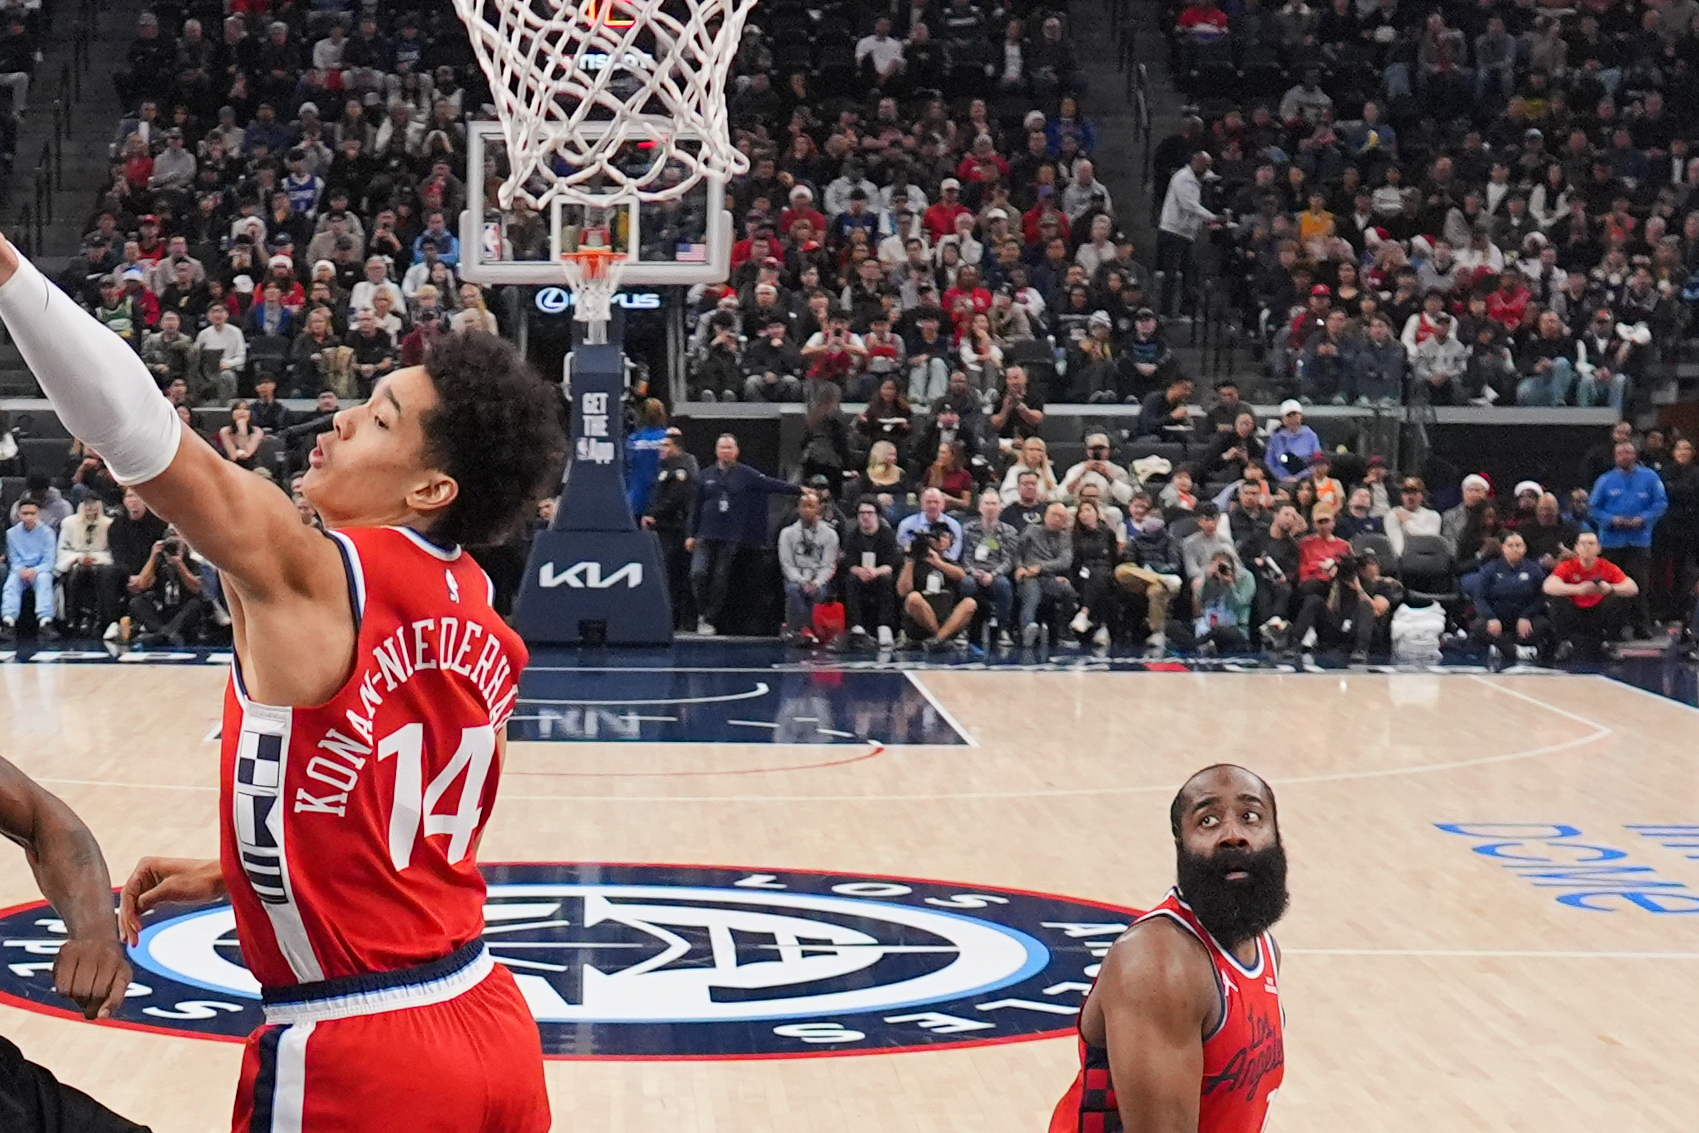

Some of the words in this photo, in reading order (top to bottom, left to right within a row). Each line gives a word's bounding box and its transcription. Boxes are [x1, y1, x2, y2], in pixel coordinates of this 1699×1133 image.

[582, 392, 609, 414] GET
[538, 561, 643, 588] KIA
[376, 722, 496, 872] 14
